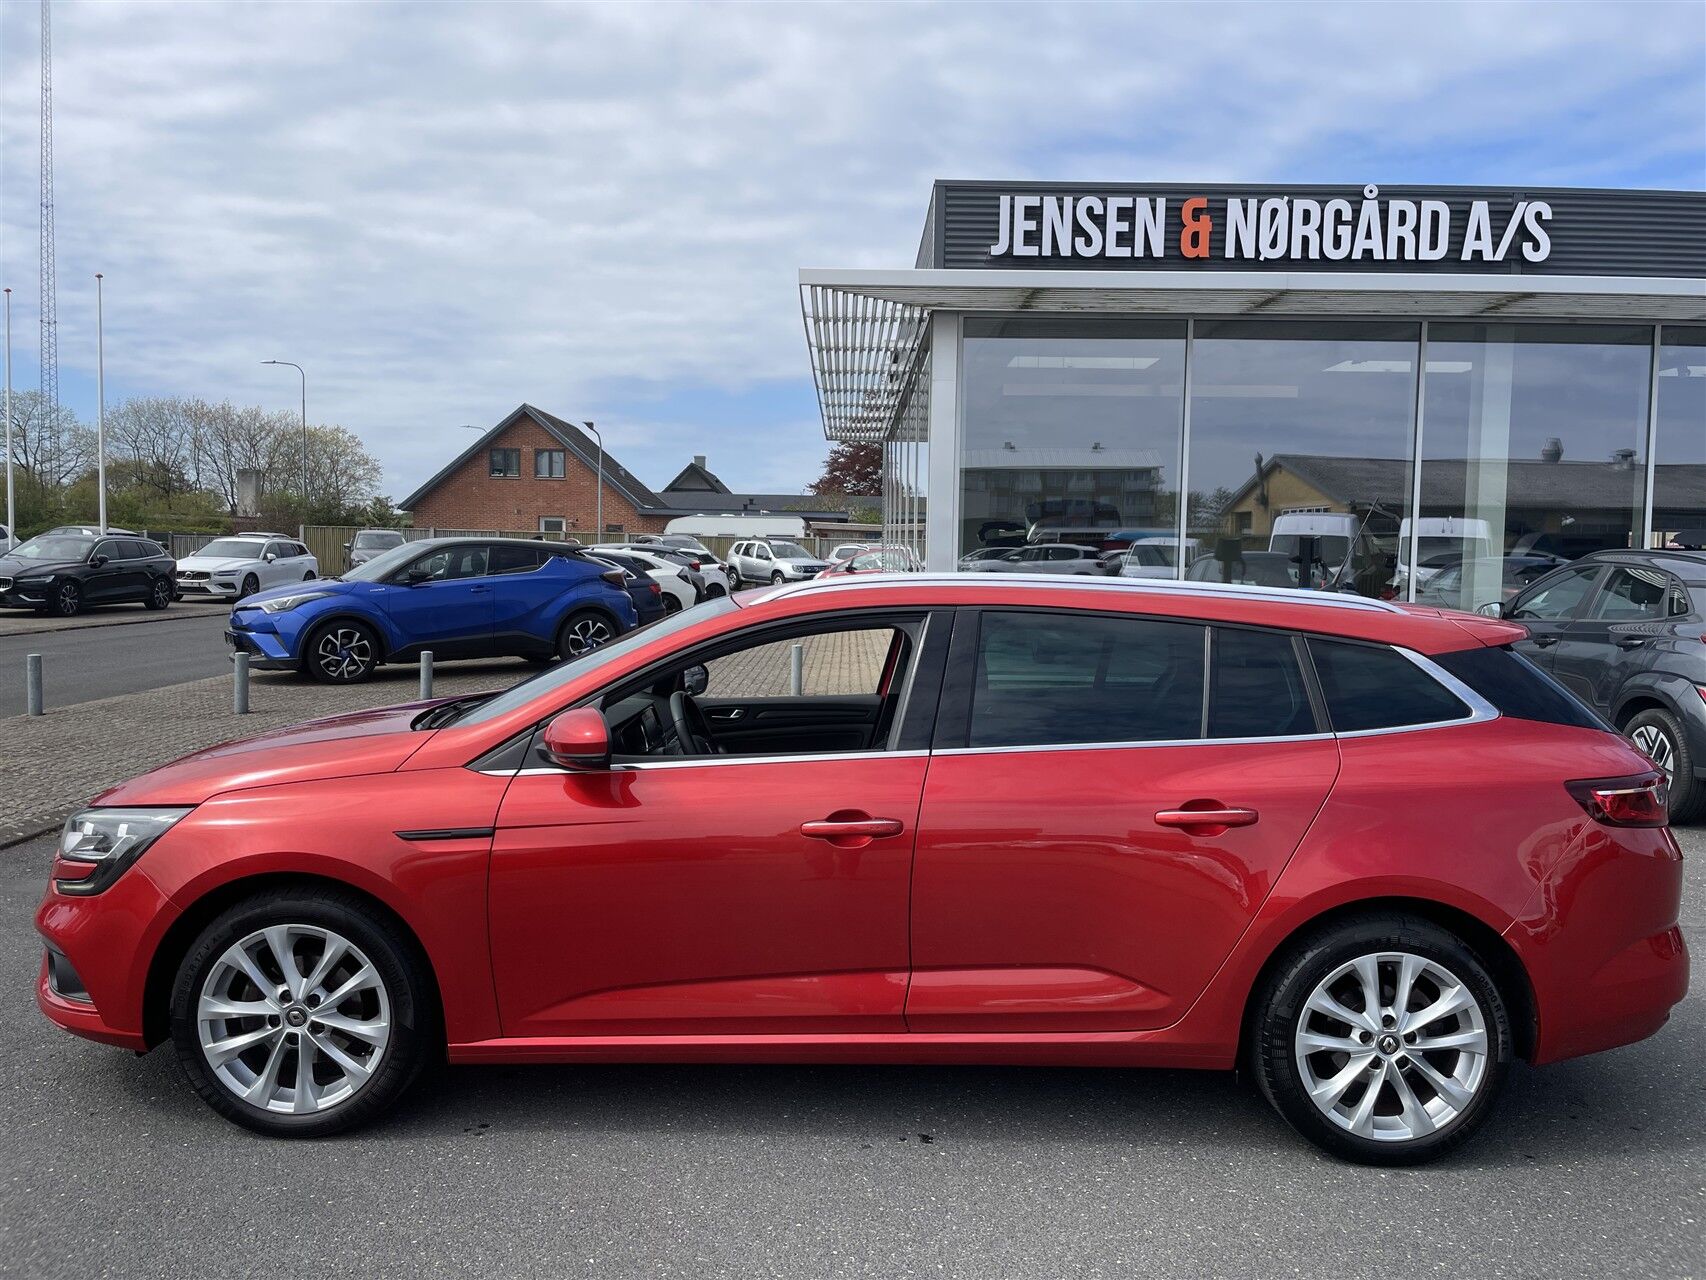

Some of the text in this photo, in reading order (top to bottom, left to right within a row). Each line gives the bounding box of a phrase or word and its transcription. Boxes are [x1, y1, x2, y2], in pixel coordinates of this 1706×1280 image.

[991, 184, 1553, 262] JENSEN & NØRGÅRD A/S
